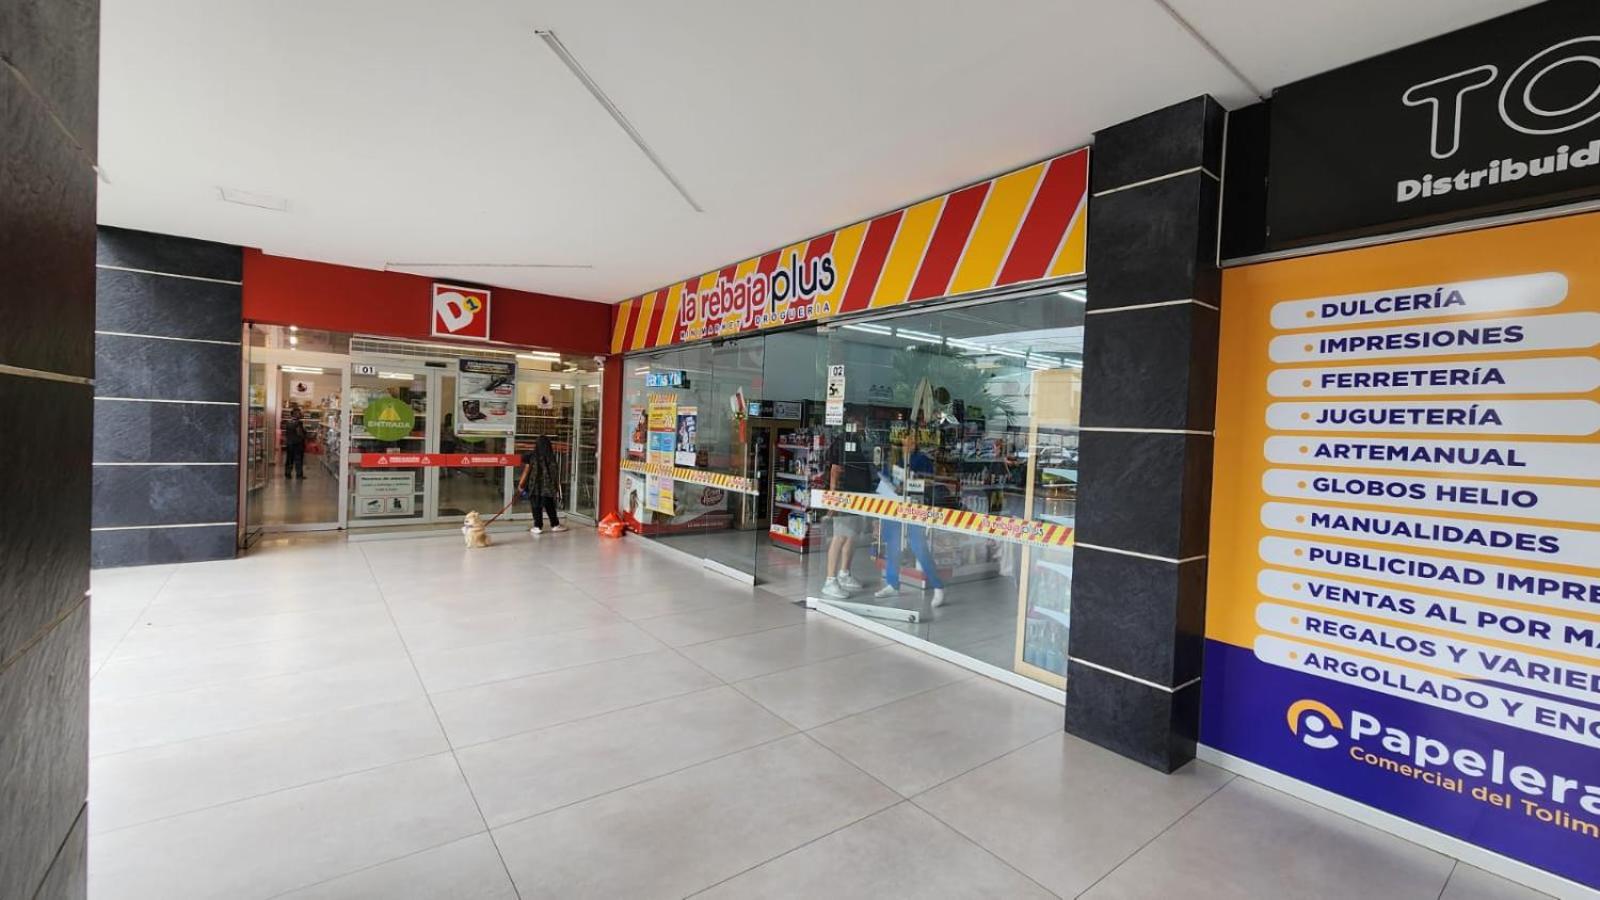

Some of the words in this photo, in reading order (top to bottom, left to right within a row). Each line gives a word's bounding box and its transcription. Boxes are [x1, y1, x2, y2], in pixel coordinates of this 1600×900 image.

[1397, 140, 1600, 202] Distribuid
[682, 292, 696, 322] la
[1321, 287, 1466, 318] DULCERÍA
[1320, 325, 1524, 354] IMPRESIONES
[362, 366, 374, 374] 01
[833, 366, 843, 376] 02
[1316, 405, 1503, 426] JUGUETERÍA
[1314, 443, 1526, 467] ARTEMANUAL
[1313, 477, 1426, 500] GLOBOS
[1436, 485, 1538, 508] HELIO
[1311, 513, 1560, 553] MANUALIDADES
[1309, 547, 1485, 585] PUBLICIDAD
[1308, 582, 1416, 614] VENTAS
[1425, 603, 1466, 624] AL
[1477, 611, 1551, 640] POR
[1564, 625, 1600, 649] M
[1306, 616, 1436, 657] REGALOS
[1447, 645, 1468, 663] Y
[1304, 652, 1488, 709] ARGOLLADO
[1500, 698, 1523, 718] Y
[1350, 746, 1463, 793] Comercial
[1471, 786, 1511, 810] del
